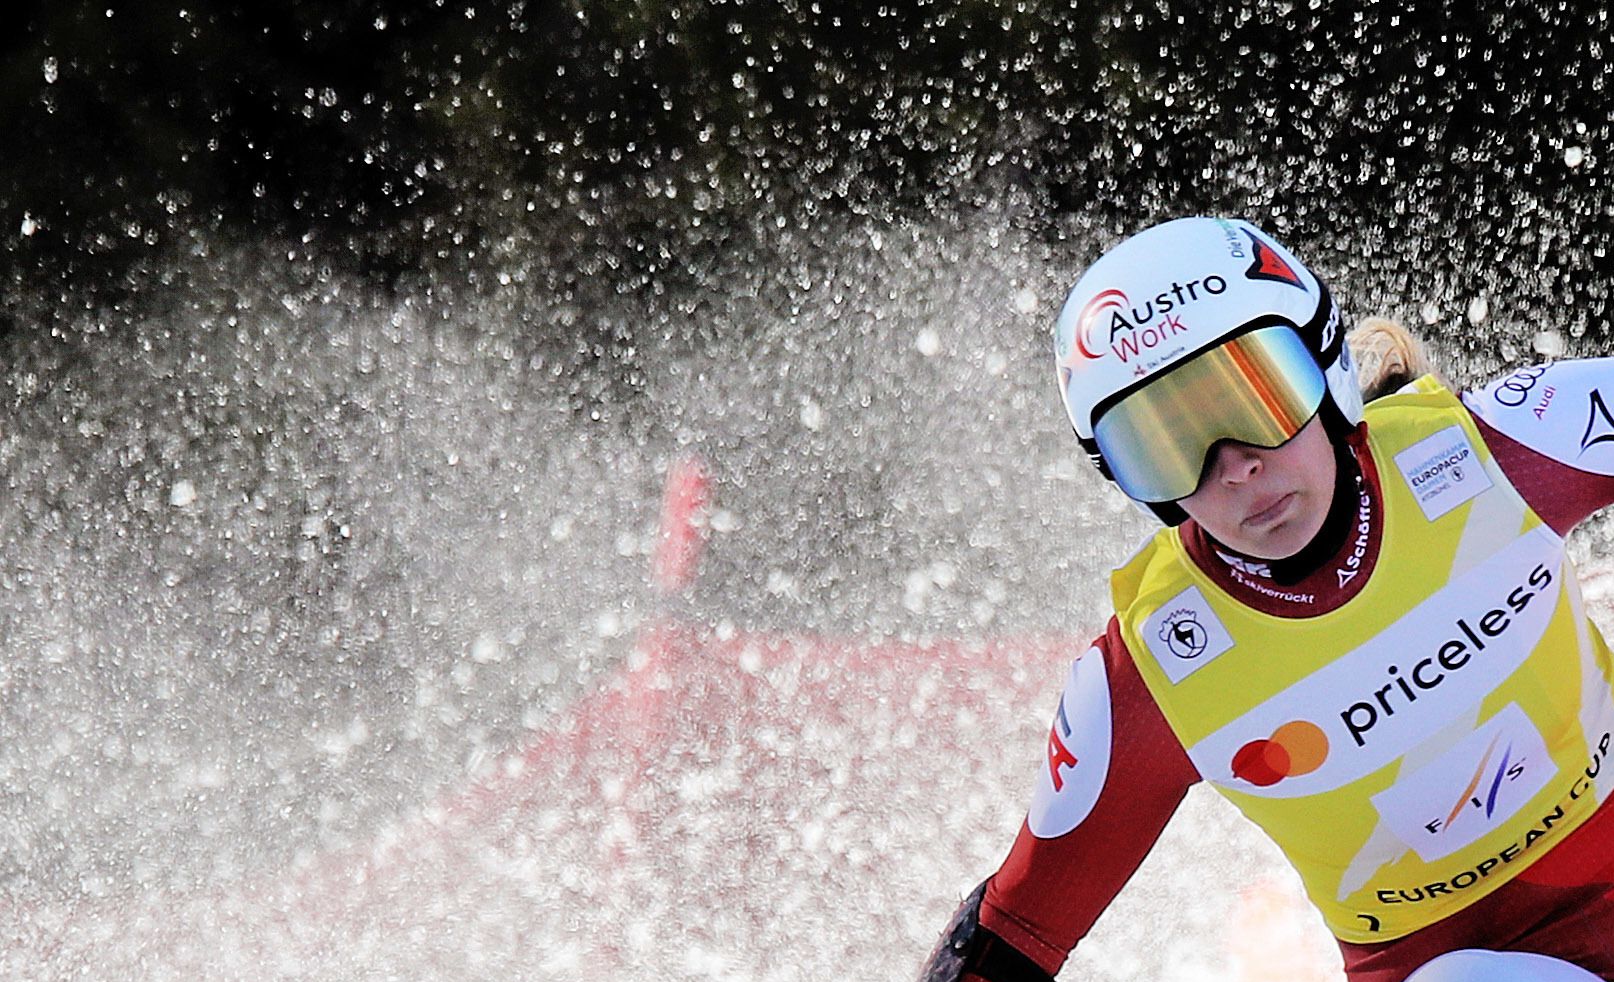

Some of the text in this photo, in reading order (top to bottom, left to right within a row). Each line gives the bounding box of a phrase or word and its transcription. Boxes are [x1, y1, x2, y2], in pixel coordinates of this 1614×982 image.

[1109, 275, 1227, 343] Austro
[1111, 314, 1188, 363] Work
[1533, 385, 1556, 421] Audi
[1411, 449, 1469, 487] EUROPACUP
[1339, 562, 1553, 747] priceless
[1377, 732, 1611, 905] EUROPEAN CUP
